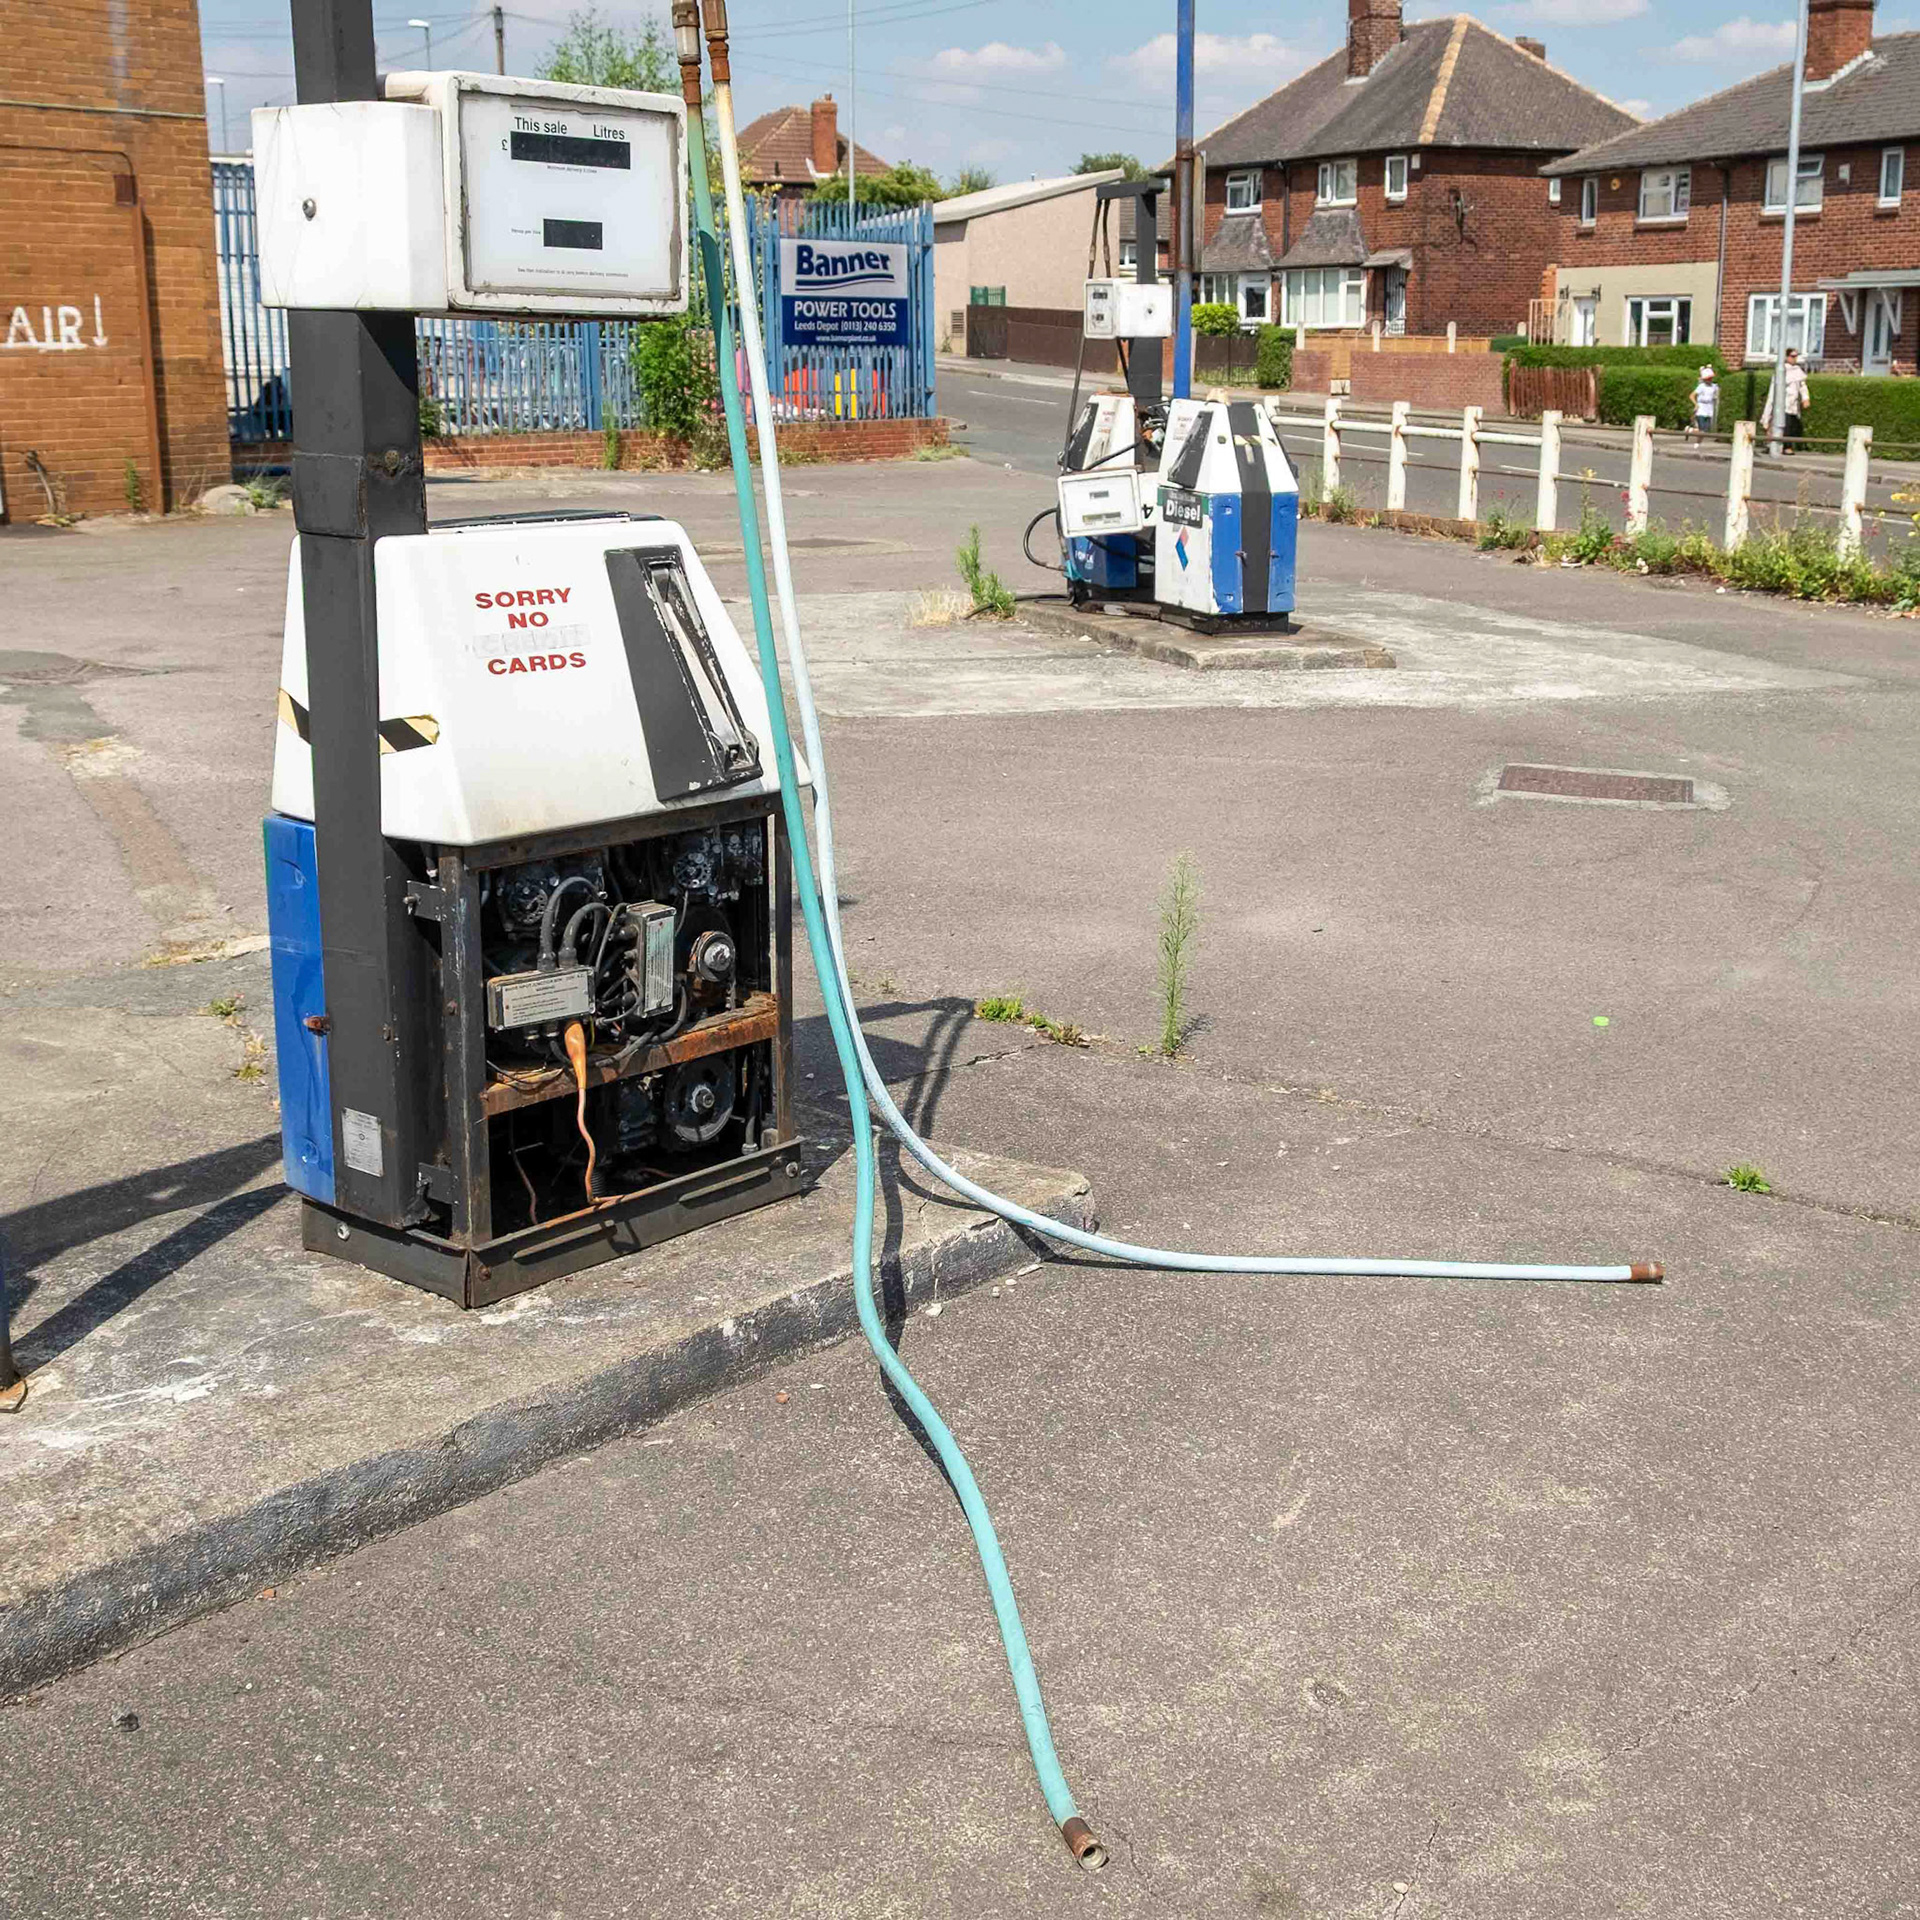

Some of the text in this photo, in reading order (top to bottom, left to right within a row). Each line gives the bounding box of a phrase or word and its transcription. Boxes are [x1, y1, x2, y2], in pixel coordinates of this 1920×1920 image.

[514, 116, 568, 135] This sale
[593, 124, 625, 140] Litres
[501, 139, 508, 151] £
[796, 244, 891, 277] Banner
[794, 300, 897, 318] POWER TOOLS
[6, 305, 84, 347] AIR
[794, 320, 897, 332] Leeds Depot (0113) 240 6350
[1166, 499, 1201, 521] Diesel
[475, 587, 571, 609] SORRY
[508, 612, 549, 629] NO
[488, 652, 586, 675] CARDS
